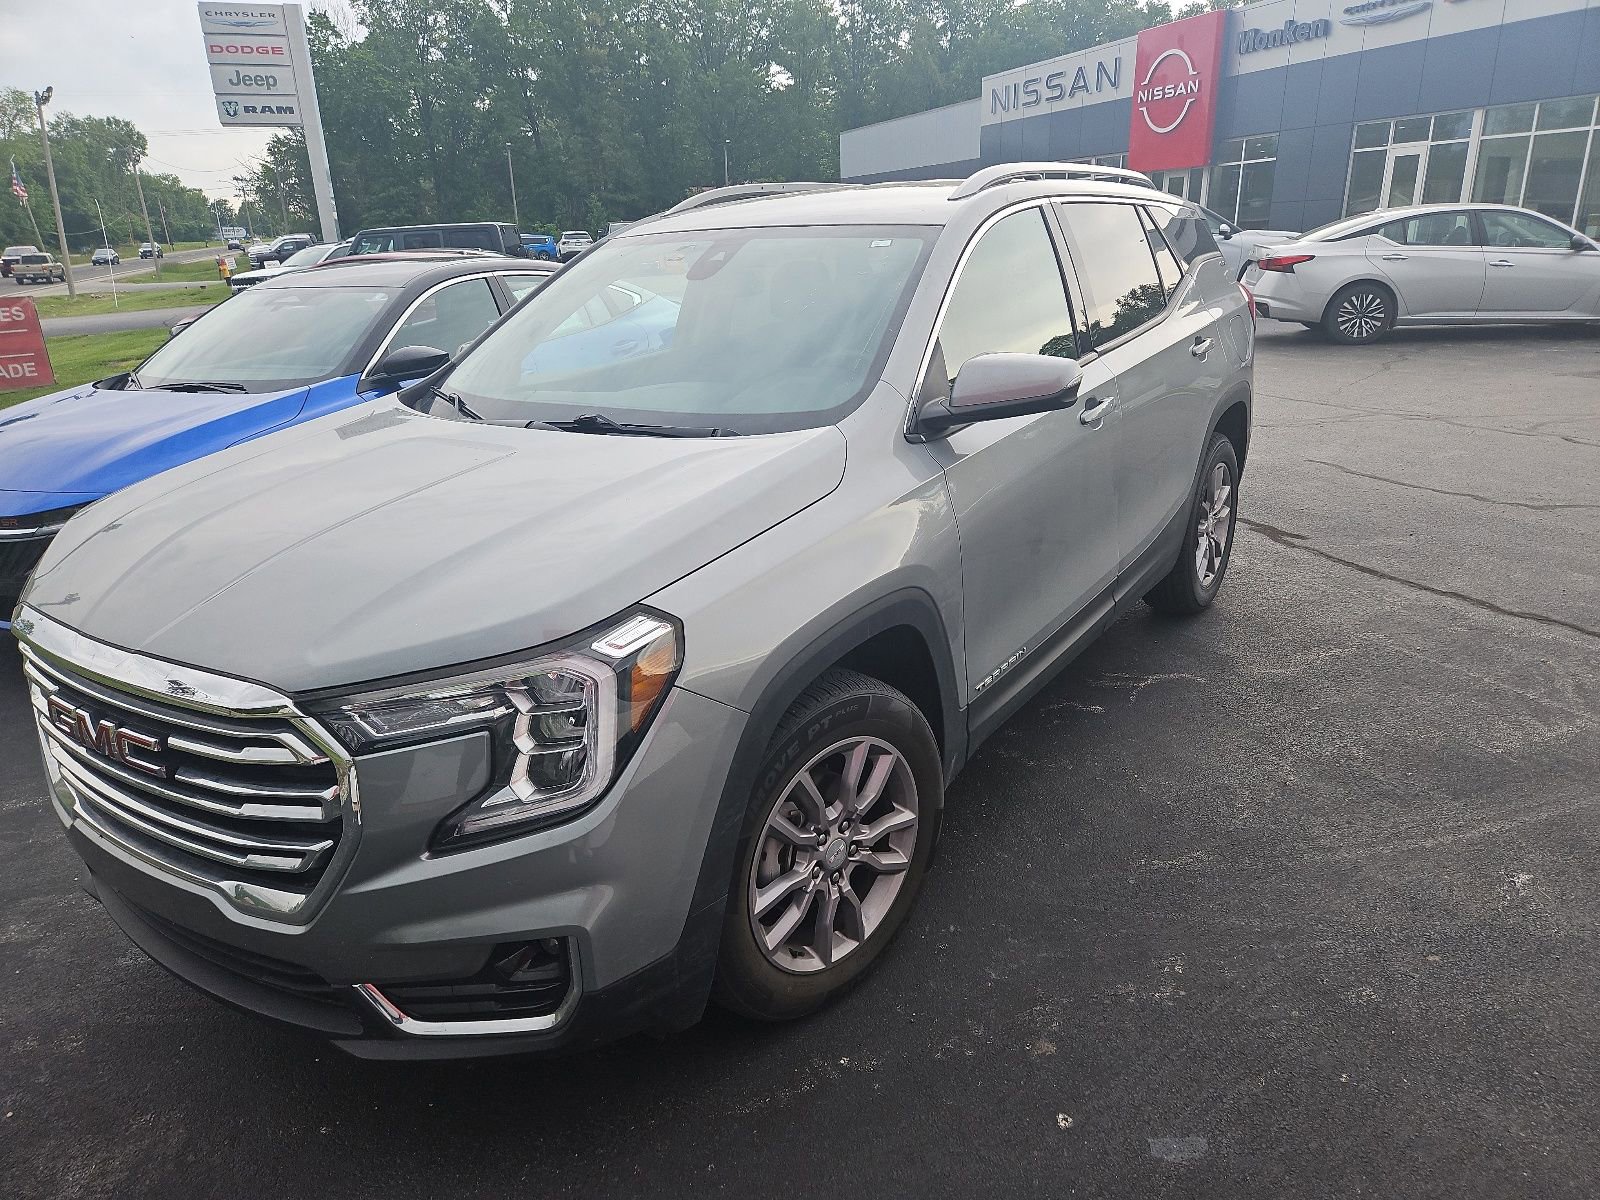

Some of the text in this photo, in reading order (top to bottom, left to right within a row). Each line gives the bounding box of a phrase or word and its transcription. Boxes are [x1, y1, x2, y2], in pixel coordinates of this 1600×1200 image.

[205, 10, 277, 18] CHRYSLER
[1239, 19, 1330, 54] Monken
[209, 44, 285, 55] DODGE
[228, 69, 278, 91] Jeep
[990, 56, 1121, 115] NISSAN
[1137, 79, 1199, 104] NISSAN
[243, 105, 295, 115] RAM
[47, 694, 167, 779] GMC
